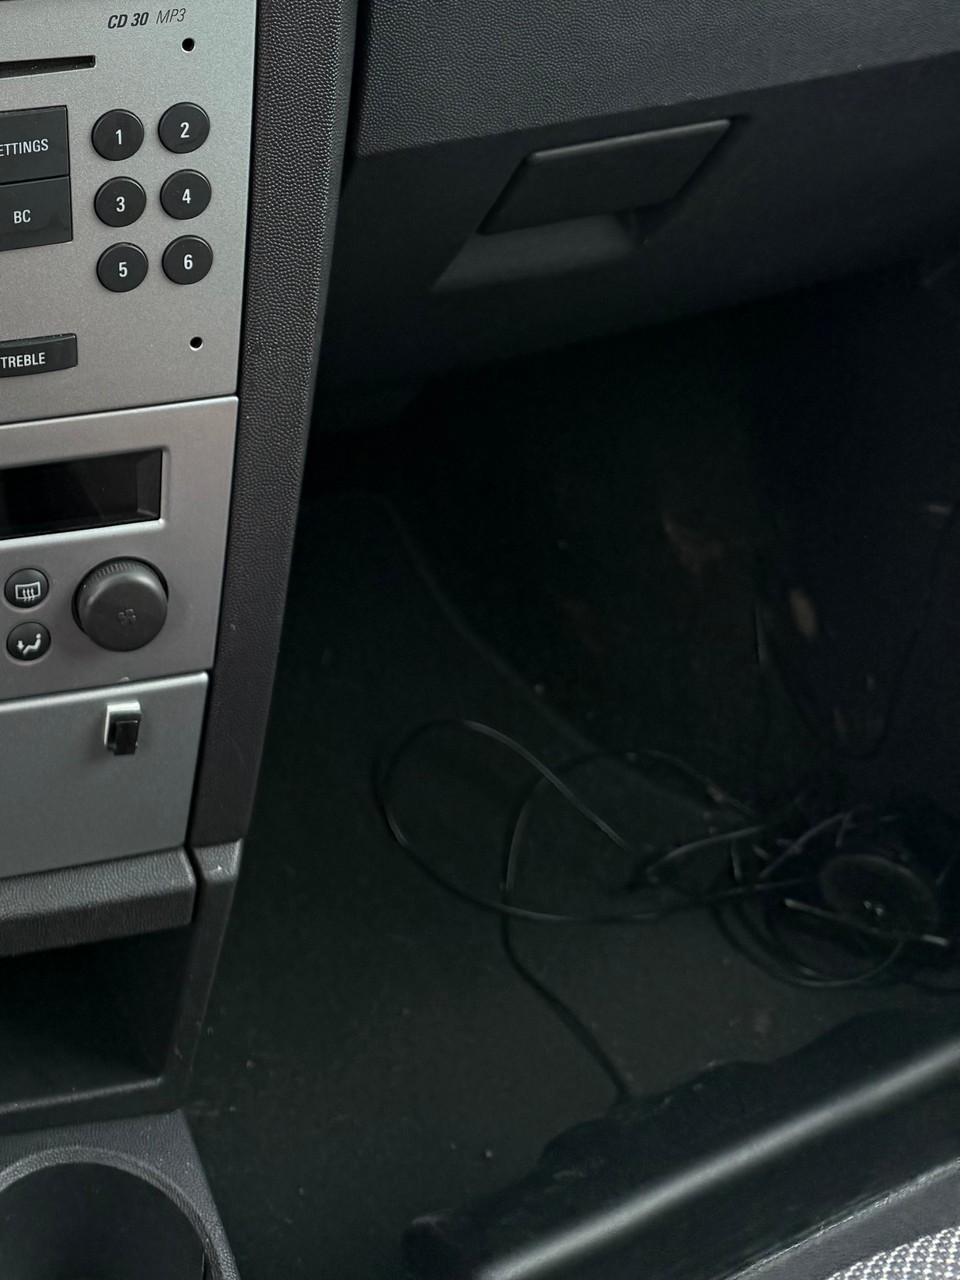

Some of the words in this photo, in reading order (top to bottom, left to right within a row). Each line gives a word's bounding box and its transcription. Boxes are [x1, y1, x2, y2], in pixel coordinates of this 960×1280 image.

[107, 14, 128, 29] CD
[131, 11, 150, 27] 30
[156, 8, 187, 25] MP3
[115, 130, 123, 145] 1
[180, 122, 190, 138] 2
[116, 196, 126, 212] 3
[182, 188, 191, 204] 4
[13, 209, 31, 224] BC
[118, 262, 128, 278] 5
[183, 254, 193, 270] 6
[0, 352, 46, 369] TREBLE
